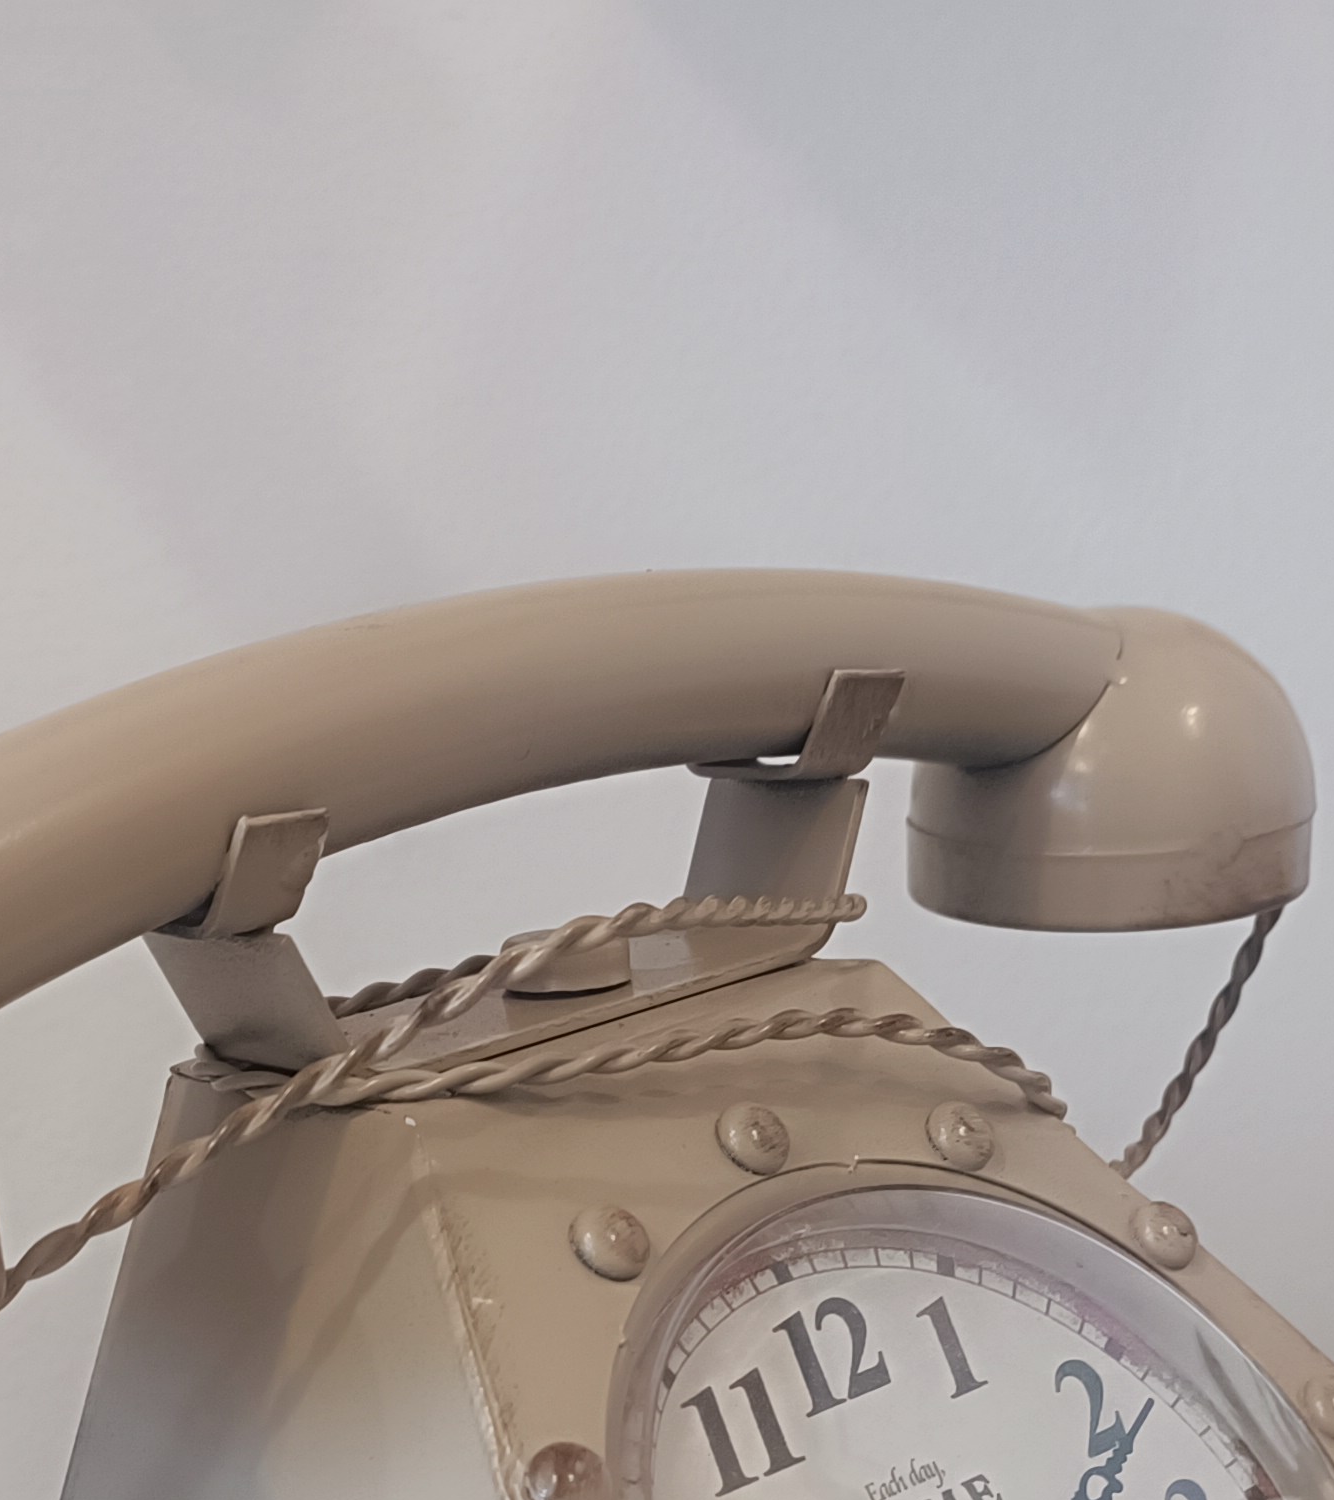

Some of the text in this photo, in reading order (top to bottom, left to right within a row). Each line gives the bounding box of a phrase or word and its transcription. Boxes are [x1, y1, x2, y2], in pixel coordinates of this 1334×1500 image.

[772, 1296, 891, 1417] 12
[916, 1296, 988, 1399] 1
[680, 1367, 805, 1497] 11
[1055, 1359, 1127, 1458] 2
